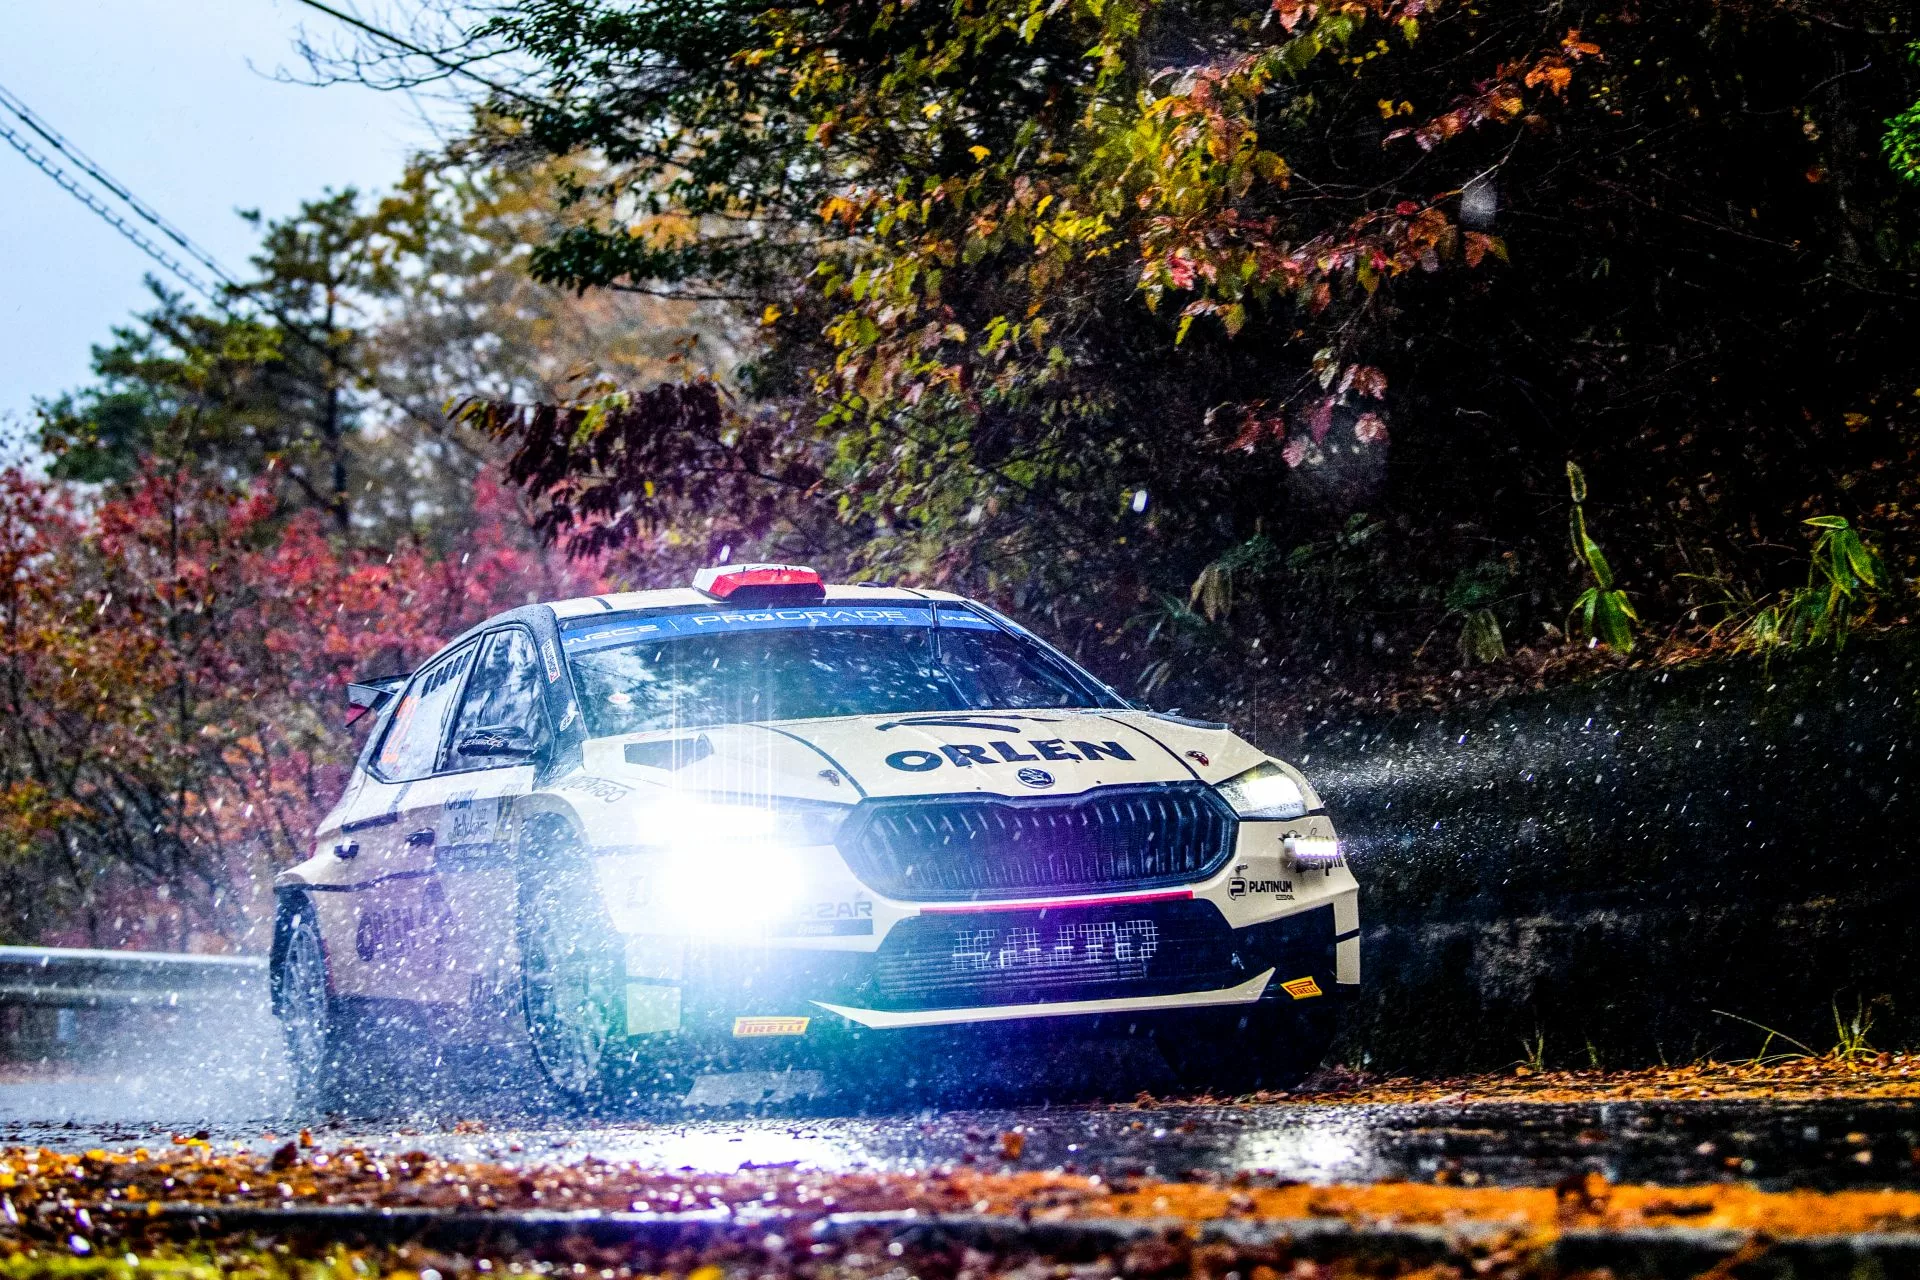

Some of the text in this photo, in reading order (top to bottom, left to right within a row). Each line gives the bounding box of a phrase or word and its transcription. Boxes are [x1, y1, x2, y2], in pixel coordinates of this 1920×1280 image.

[884, 738, 1137, 773] ORLEN
[1249, 880, 1293, 893] PLATINUM
[1286, 980, 1318, 996] PIRELLI
[737, 1018, 805, 1034] PIRELLI
